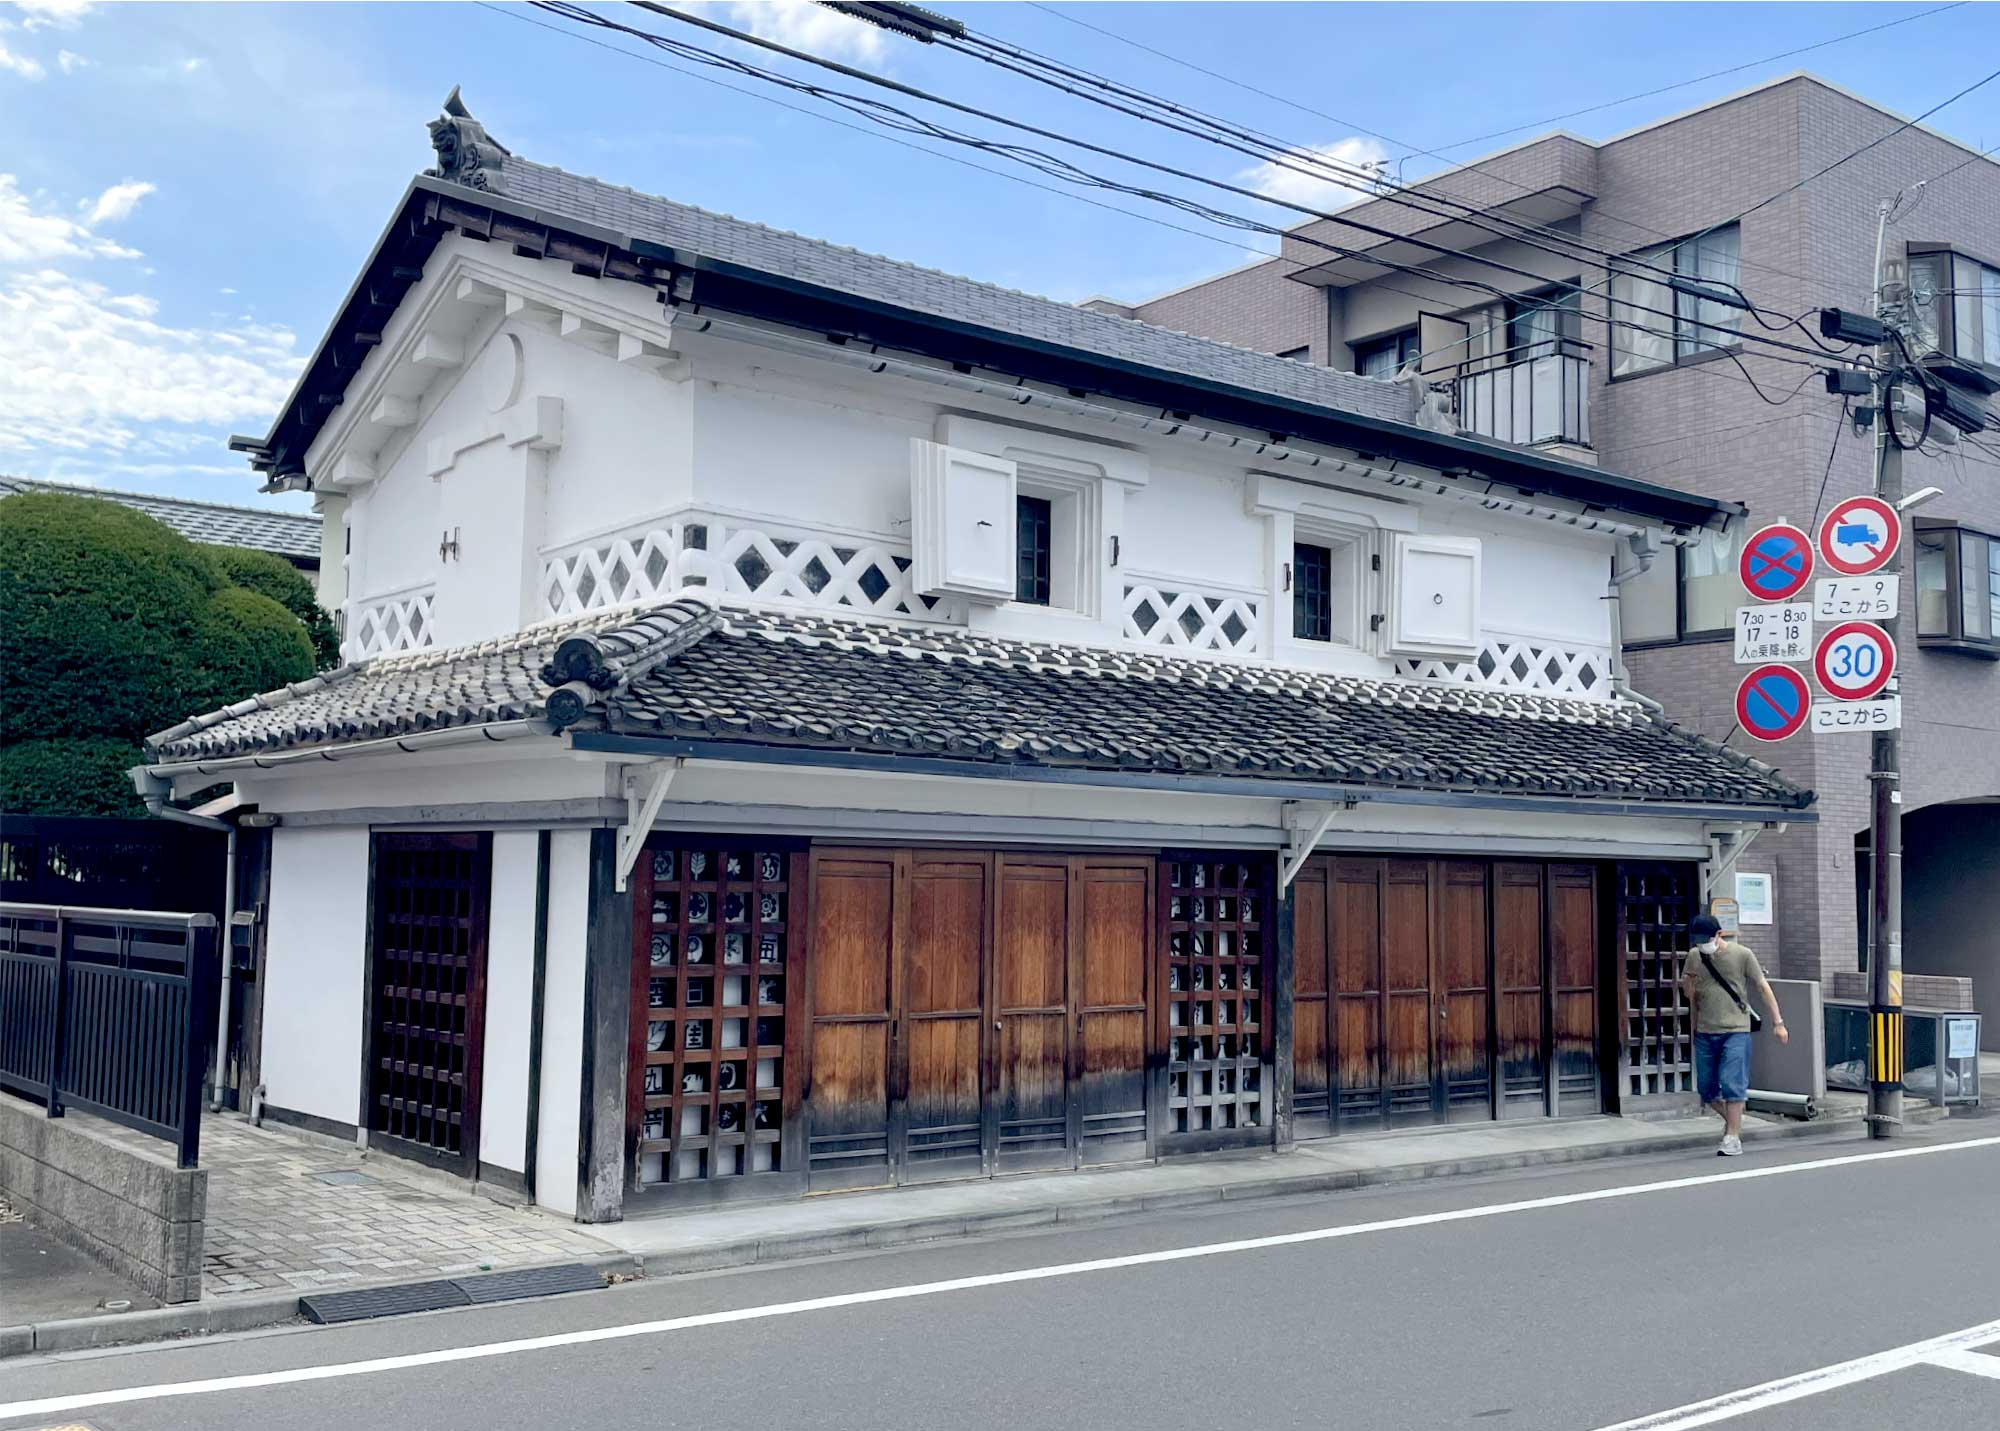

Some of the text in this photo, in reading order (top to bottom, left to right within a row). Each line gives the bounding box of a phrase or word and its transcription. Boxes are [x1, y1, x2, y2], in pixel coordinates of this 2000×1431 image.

[1828, 584, 1838, 598] 7
[1875, 581, 1884, 596] 9
[1822, 600, 1889, 615] ここから
[1747, 628, 1761, 642] 17
[1786, 626, 1799, 640] 18
[1832, 644, 1876, 677] 30
[1819, 707, 1888, 726] ここから
